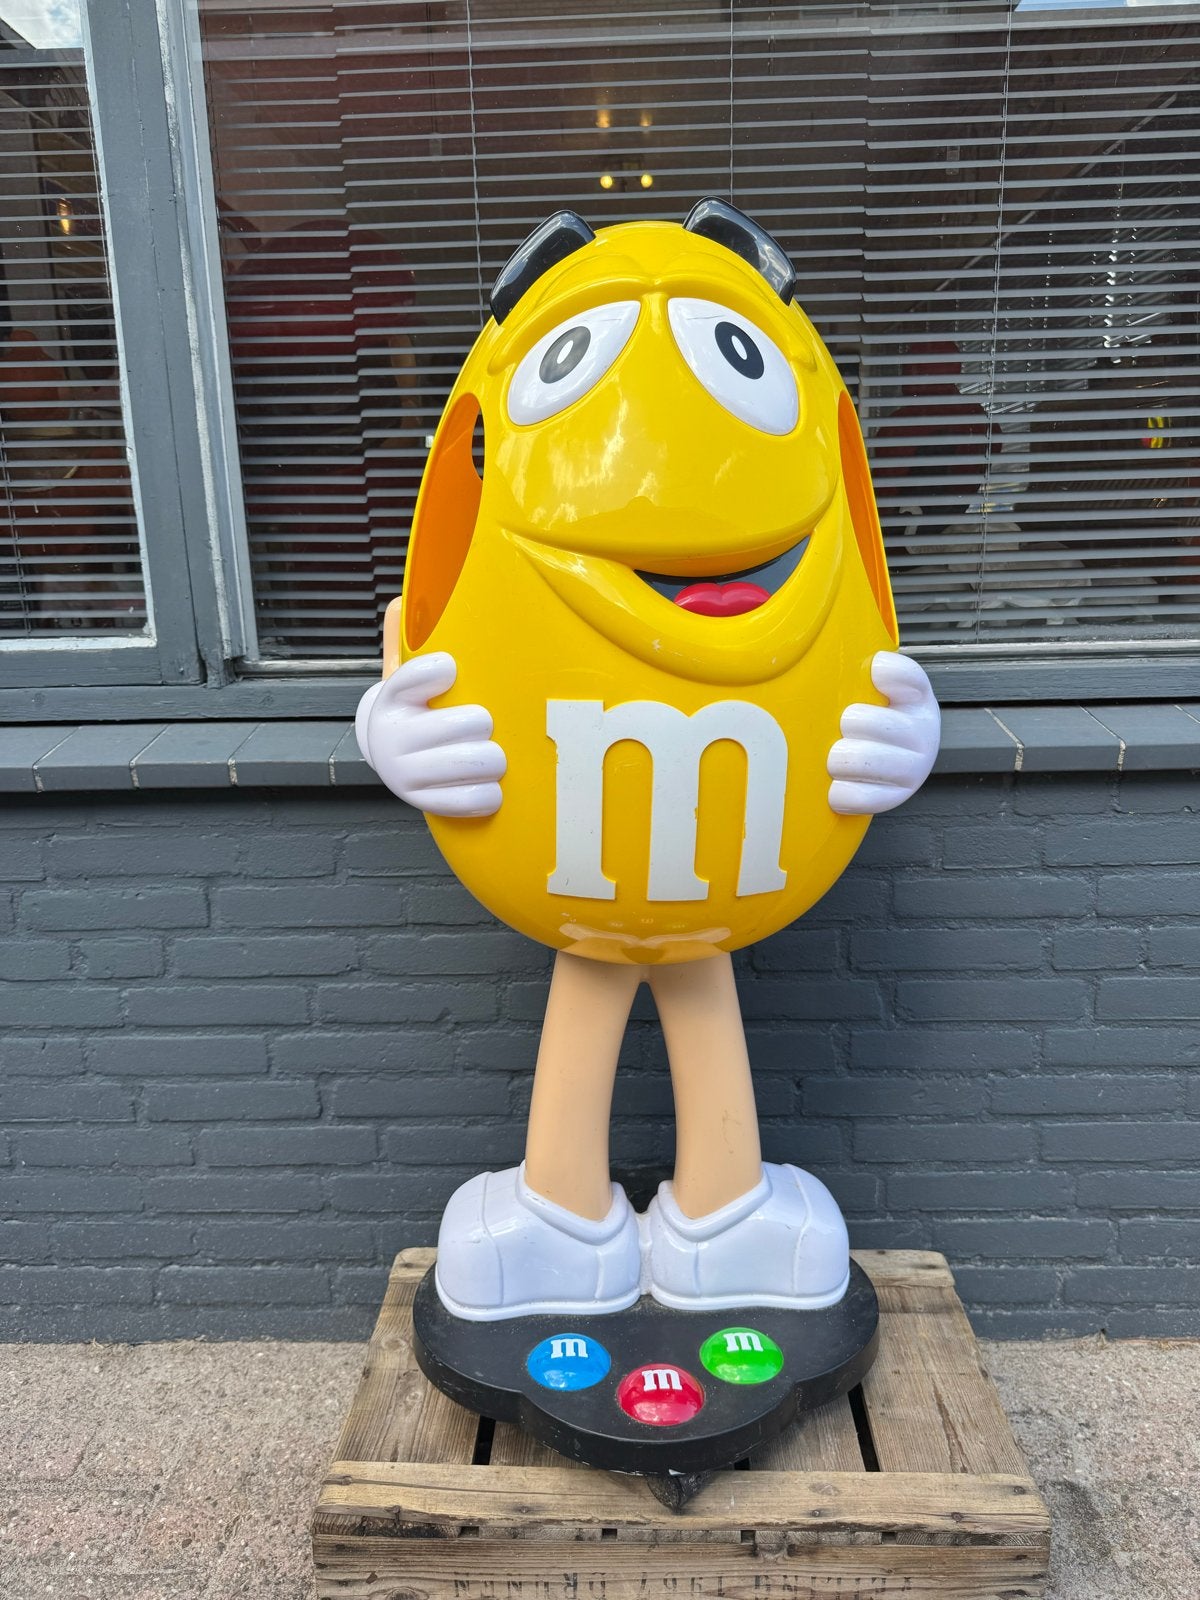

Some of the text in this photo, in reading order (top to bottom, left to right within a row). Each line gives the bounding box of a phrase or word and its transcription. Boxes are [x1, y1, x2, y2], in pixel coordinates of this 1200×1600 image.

[546, 699, 789, 901] m
[550, 1338, 588, 1358] m
[723, 1332, 763, 1352] m
[641, 1369, 682, 1391] m
